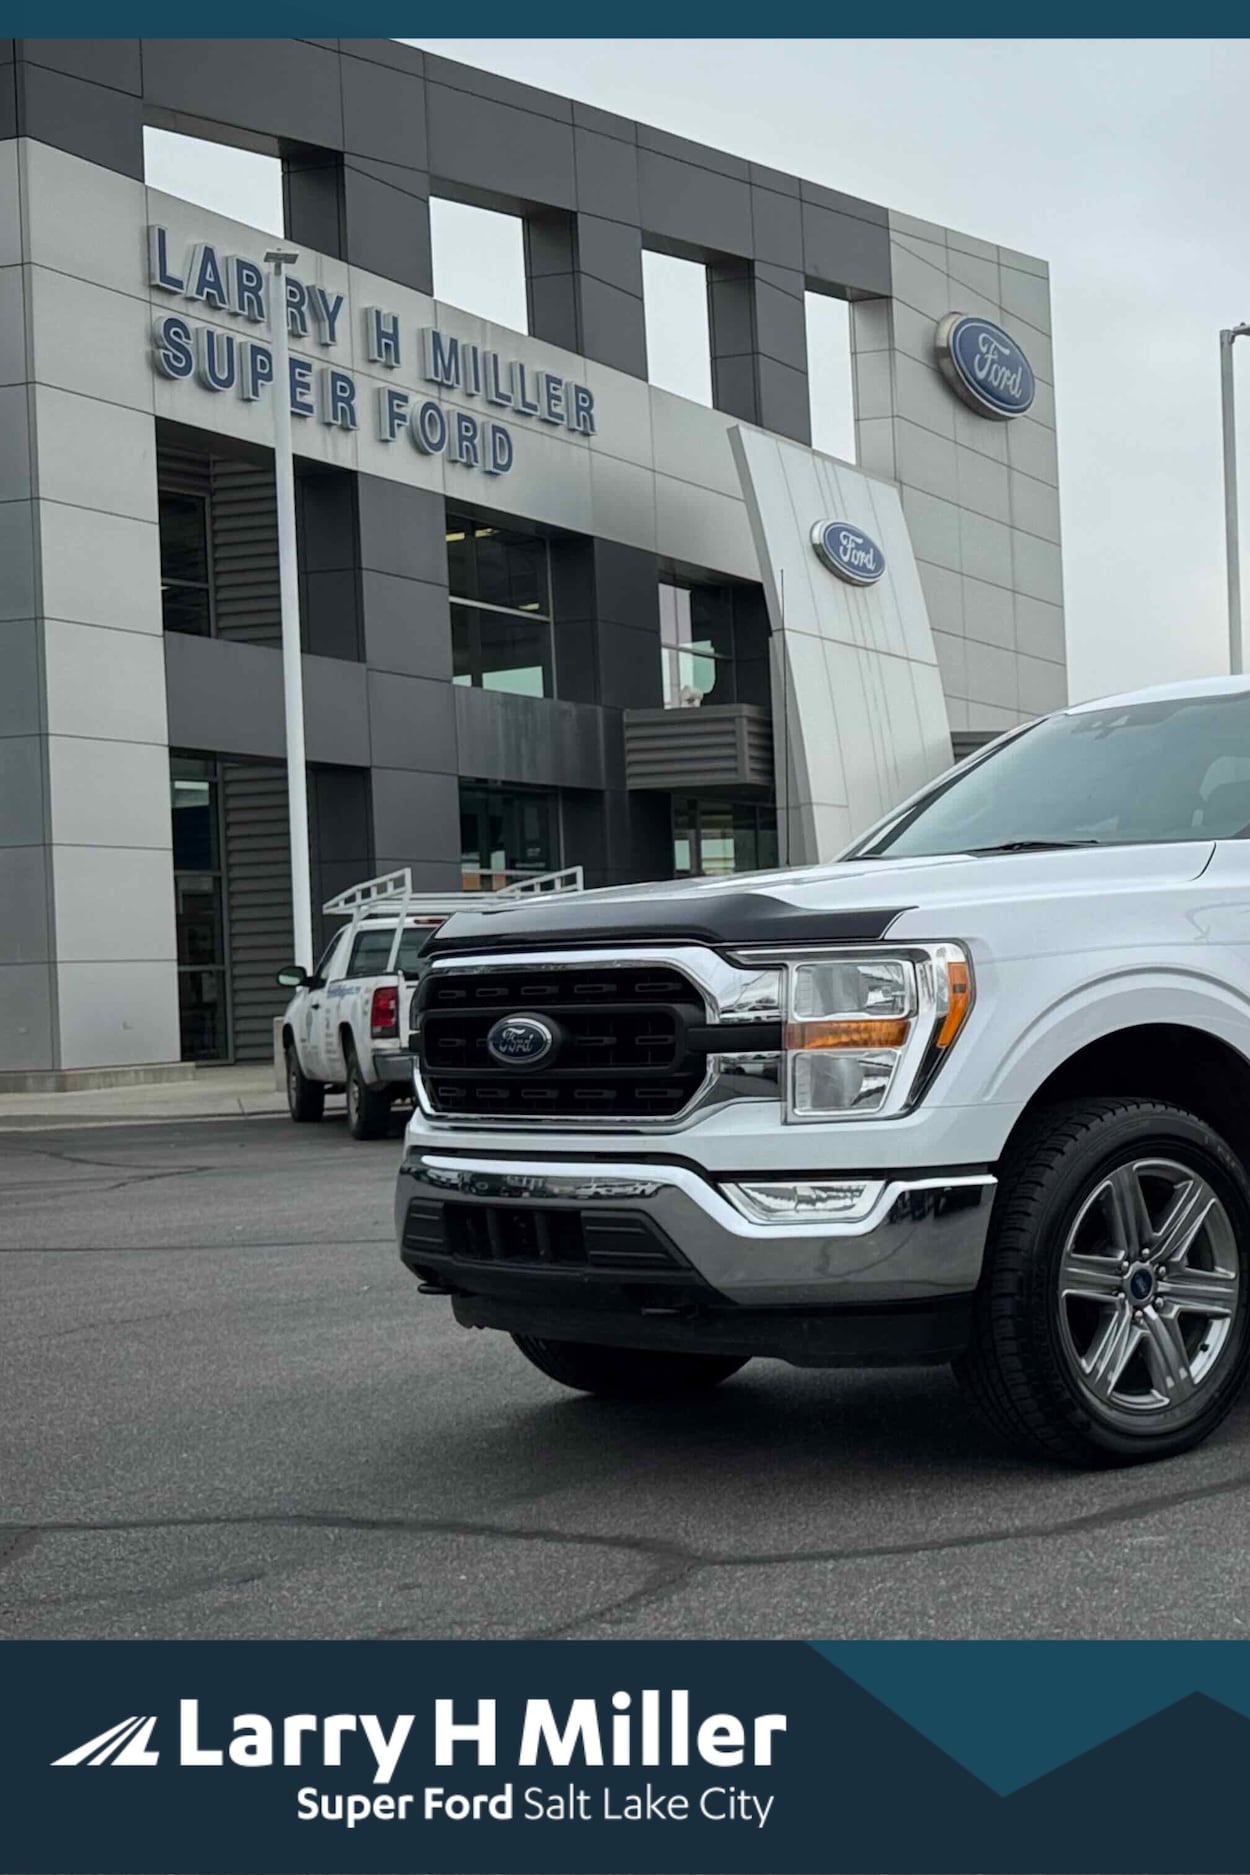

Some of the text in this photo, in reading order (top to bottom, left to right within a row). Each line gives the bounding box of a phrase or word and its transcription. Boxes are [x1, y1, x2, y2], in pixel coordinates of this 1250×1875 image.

[151, 225, 597, 436] LARRY H MILLER
[153, 315, 514, 475] SUPER FORD
[974, 332, 1022, 399] Ford
[839, 531, 875, 570] Ford
[499, 1027, 534, 1052] Ford
